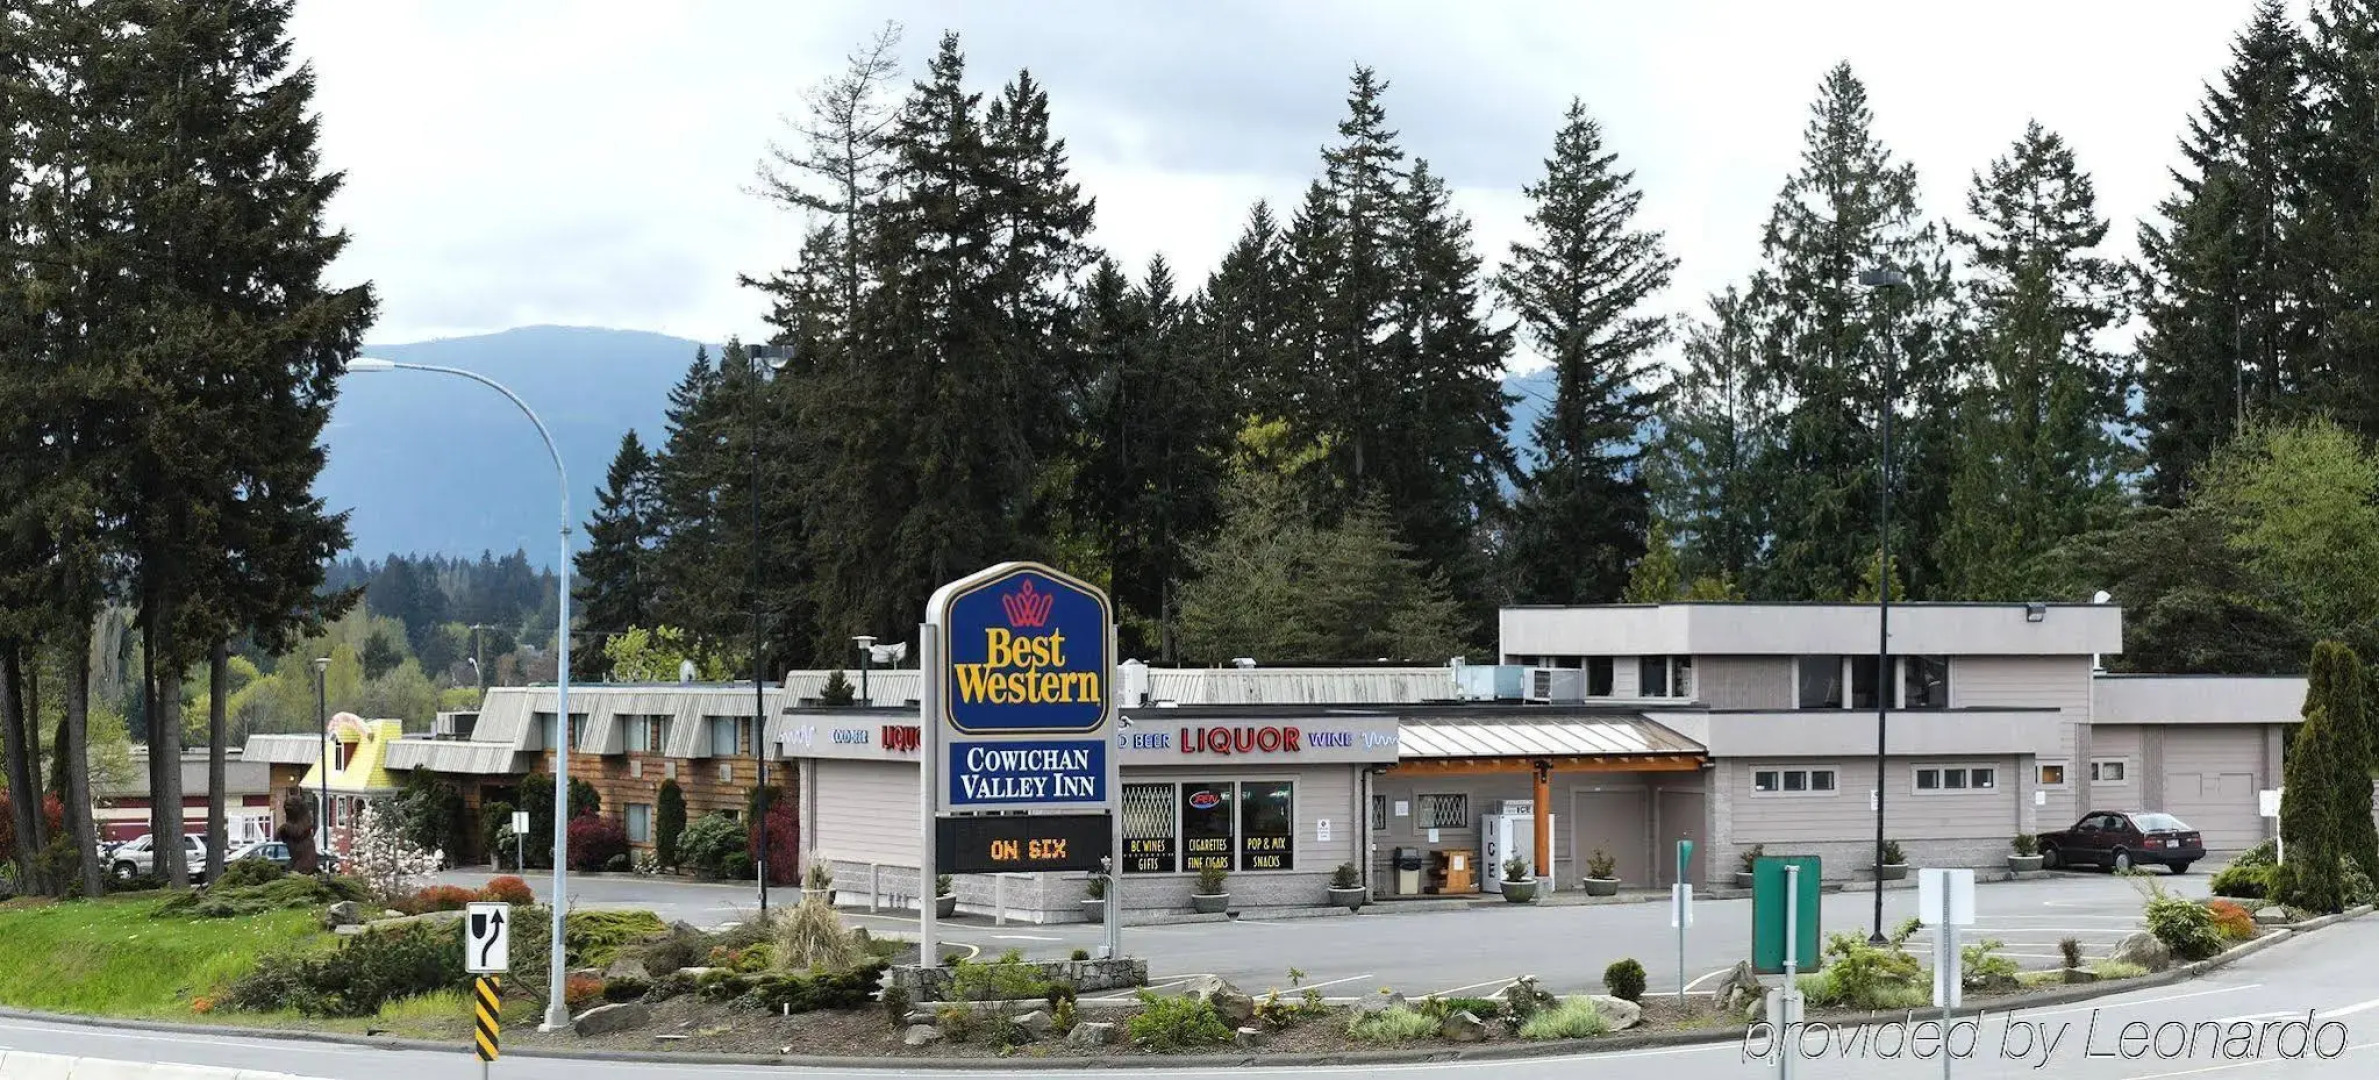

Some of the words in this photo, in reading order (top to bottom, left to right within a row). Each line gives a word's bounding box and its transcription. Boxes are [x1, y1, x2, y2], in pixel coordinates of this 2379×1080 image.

[985, 627, 1065, 668] Best
[954, 663, 1100, 704] Western
[881, 725, 921, 751] LIQUO
[1133, 733, 1171, 748] BEER
[1180, 727, 1301, 755] LIQUOR
[1308, 732, 1352, 748] WINE
[967, 747, 1089, 773] COWICHAN
[960, 774, 1048, 800] VALLEY
[1053, 772, 1095, 797] INN
[990, 839, 1018, 861] ON
[1028, 838, 1067, 859] SIX
[1130, 840, 1141, 852] BC
[1143, 839, 1166, 852] WINES
[1188, 838, 1228, 852] CIGARETTES
[1247, 837, 1262, 850] POP
[1263, 837, 1270, 850] &
[1271, 836, 1286, 850] MIX
[1138, 858, 1159, 870] GIFTS
[1187, 857, 1203, 869] FINE
[1205, 856, 1229, 869] CIGARS
[1253, 856, 1281, 868] SNACKS
